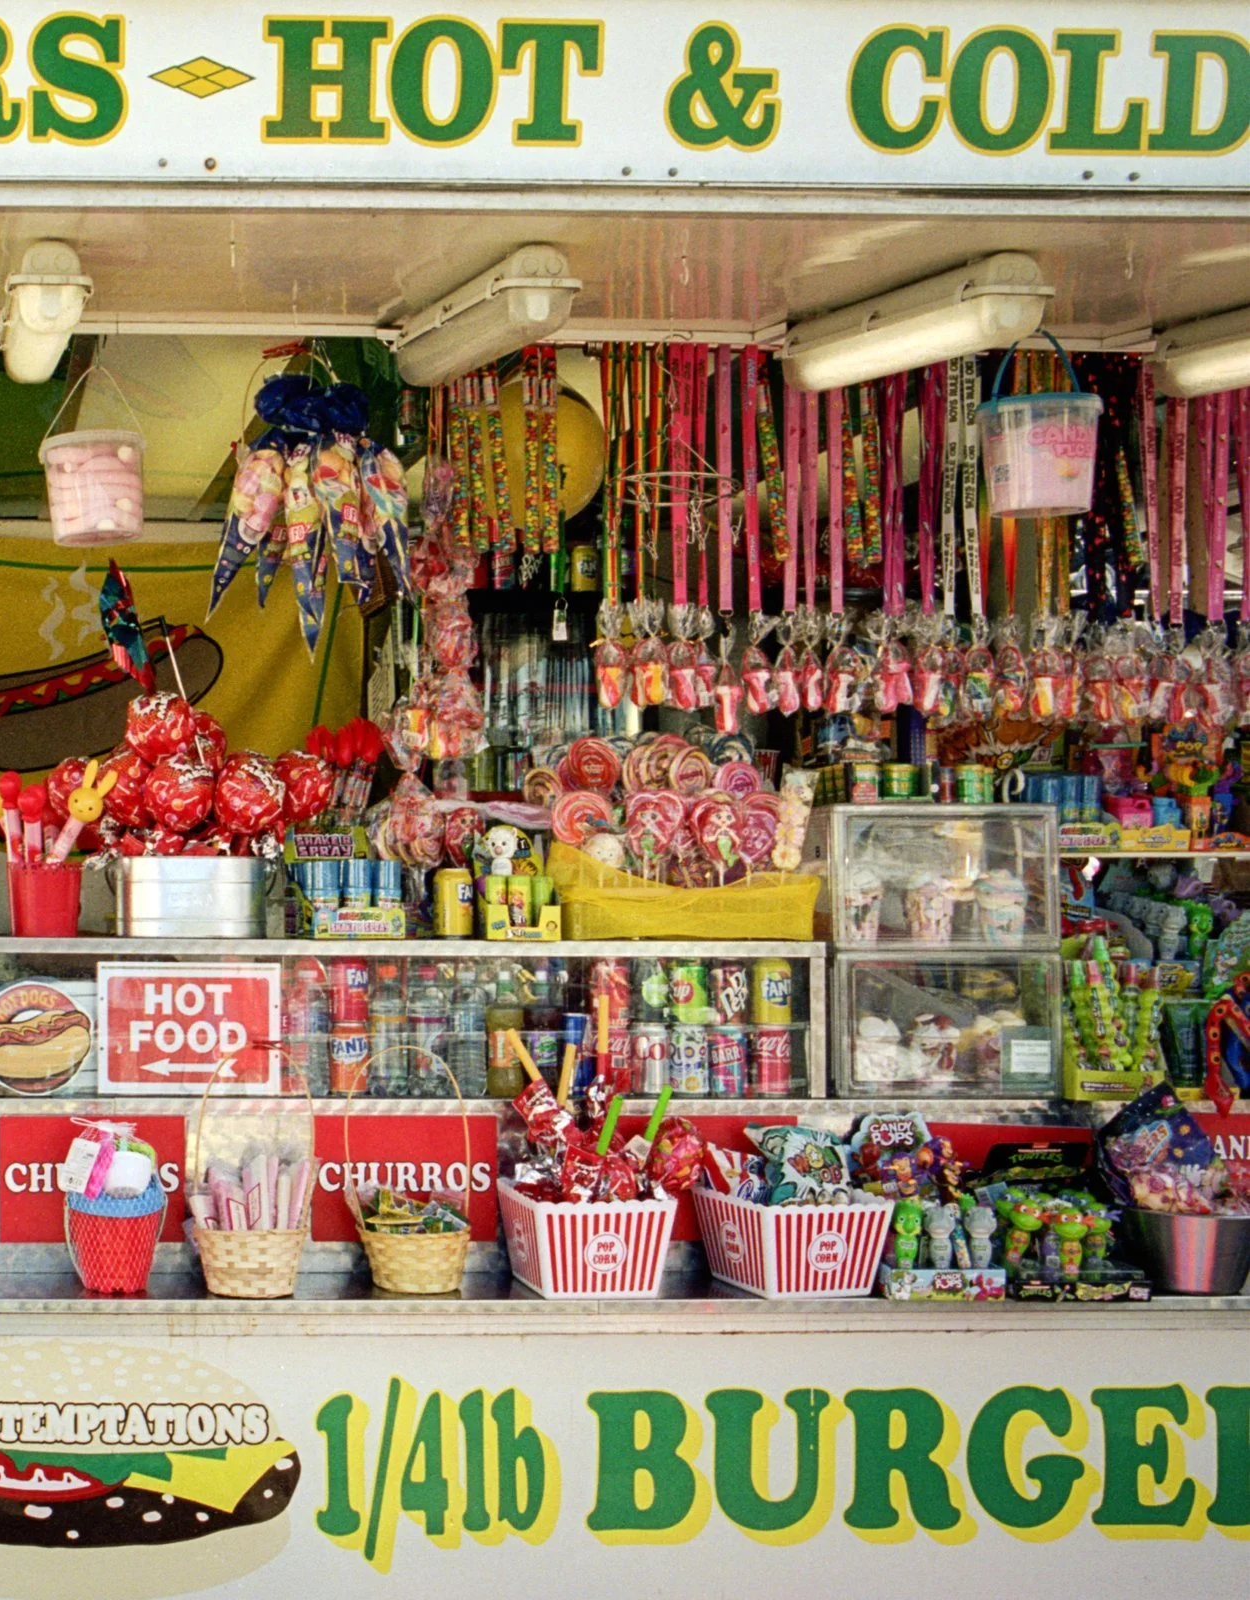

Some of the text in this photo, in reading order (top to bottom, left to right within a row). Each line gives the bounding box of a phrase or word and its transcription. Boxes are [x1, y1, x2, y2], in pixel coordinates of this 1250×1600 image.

[261, 15, 605, 148] HOT
[664, 23, 782, 152] &
[847, 27, 1250, 157] COLD
[298, 845, 352, 857] SPRAY
[19, 989, 58, 1009] DOGS
[143, 983, 233, 1016] HOT
[129, 1020, 248, 1054] FOOD
[711, 1044, 742, 1065] BARR
[869, 1120, 913, 1134] CANDY
[870, 1131, 915, 1146] POPS
[1008, 1151, 1064, 1164] TURTLES
[318, 1160, 492, 1193] CHURROS
[597, 1241, 615, 1253] POP
[819, 1241, 837, 1251] POP
[592, 1253, 618, 1265] CORN
[815, 1252, 839, 1263] CORN
[313, 1374, 562, 1574] 1/4lb
